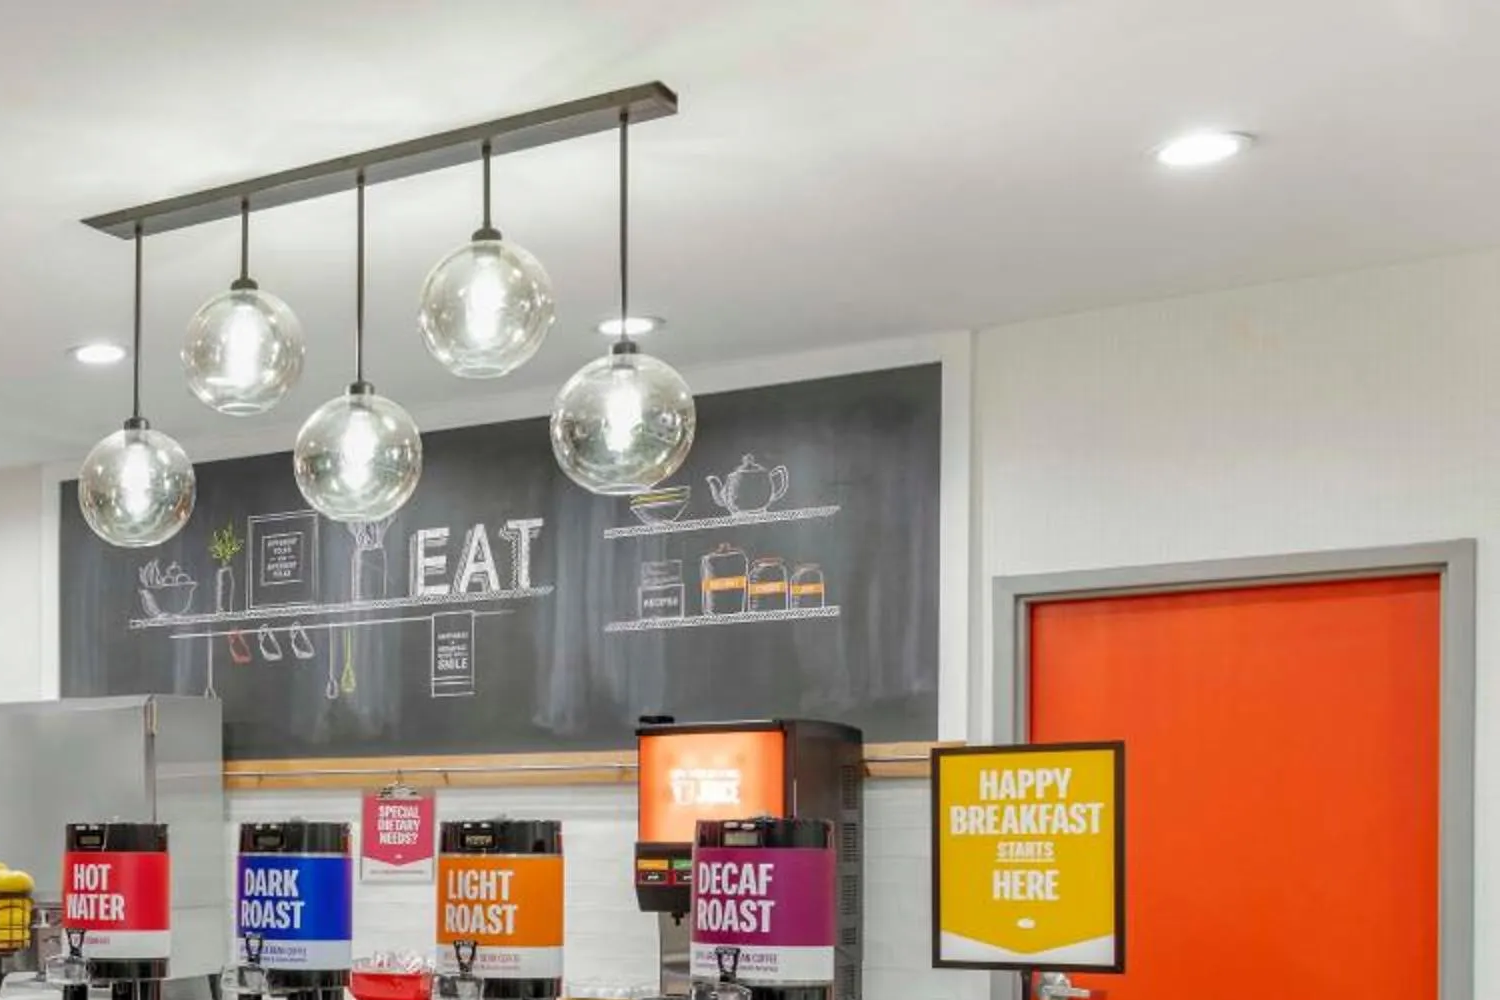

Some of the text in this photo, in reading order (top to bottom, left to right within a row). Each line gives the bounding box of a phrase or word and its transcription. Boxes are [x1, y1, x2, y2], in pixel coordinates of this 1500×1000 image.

[409, 518, 544, 597] EAT
[979, 768, 1072, 800] HAPPY
[377, 819, 420, 832] DIETARY
[378, 805, 420, 819] SPECIAL
[950, 802, 1104, 835] BREAKFAST
[380, 832, 418, 845] NEEDS?
[997, 841, 1054, 859] STARTS
[74, 863, 112, 891] HOT
[245, 868, 299, 896] DARK
[448, 869, 515, 902] LIGHT
[699, 862, 774, 895] DECAF
[992, 869, 1060, 901] HERE
[67, 894, 125, 920] WATER
[241, 899, 306, 929] ROAST
[445, 903, 518, 935] ROAST
[697, 898, 775, 933] ROAST
